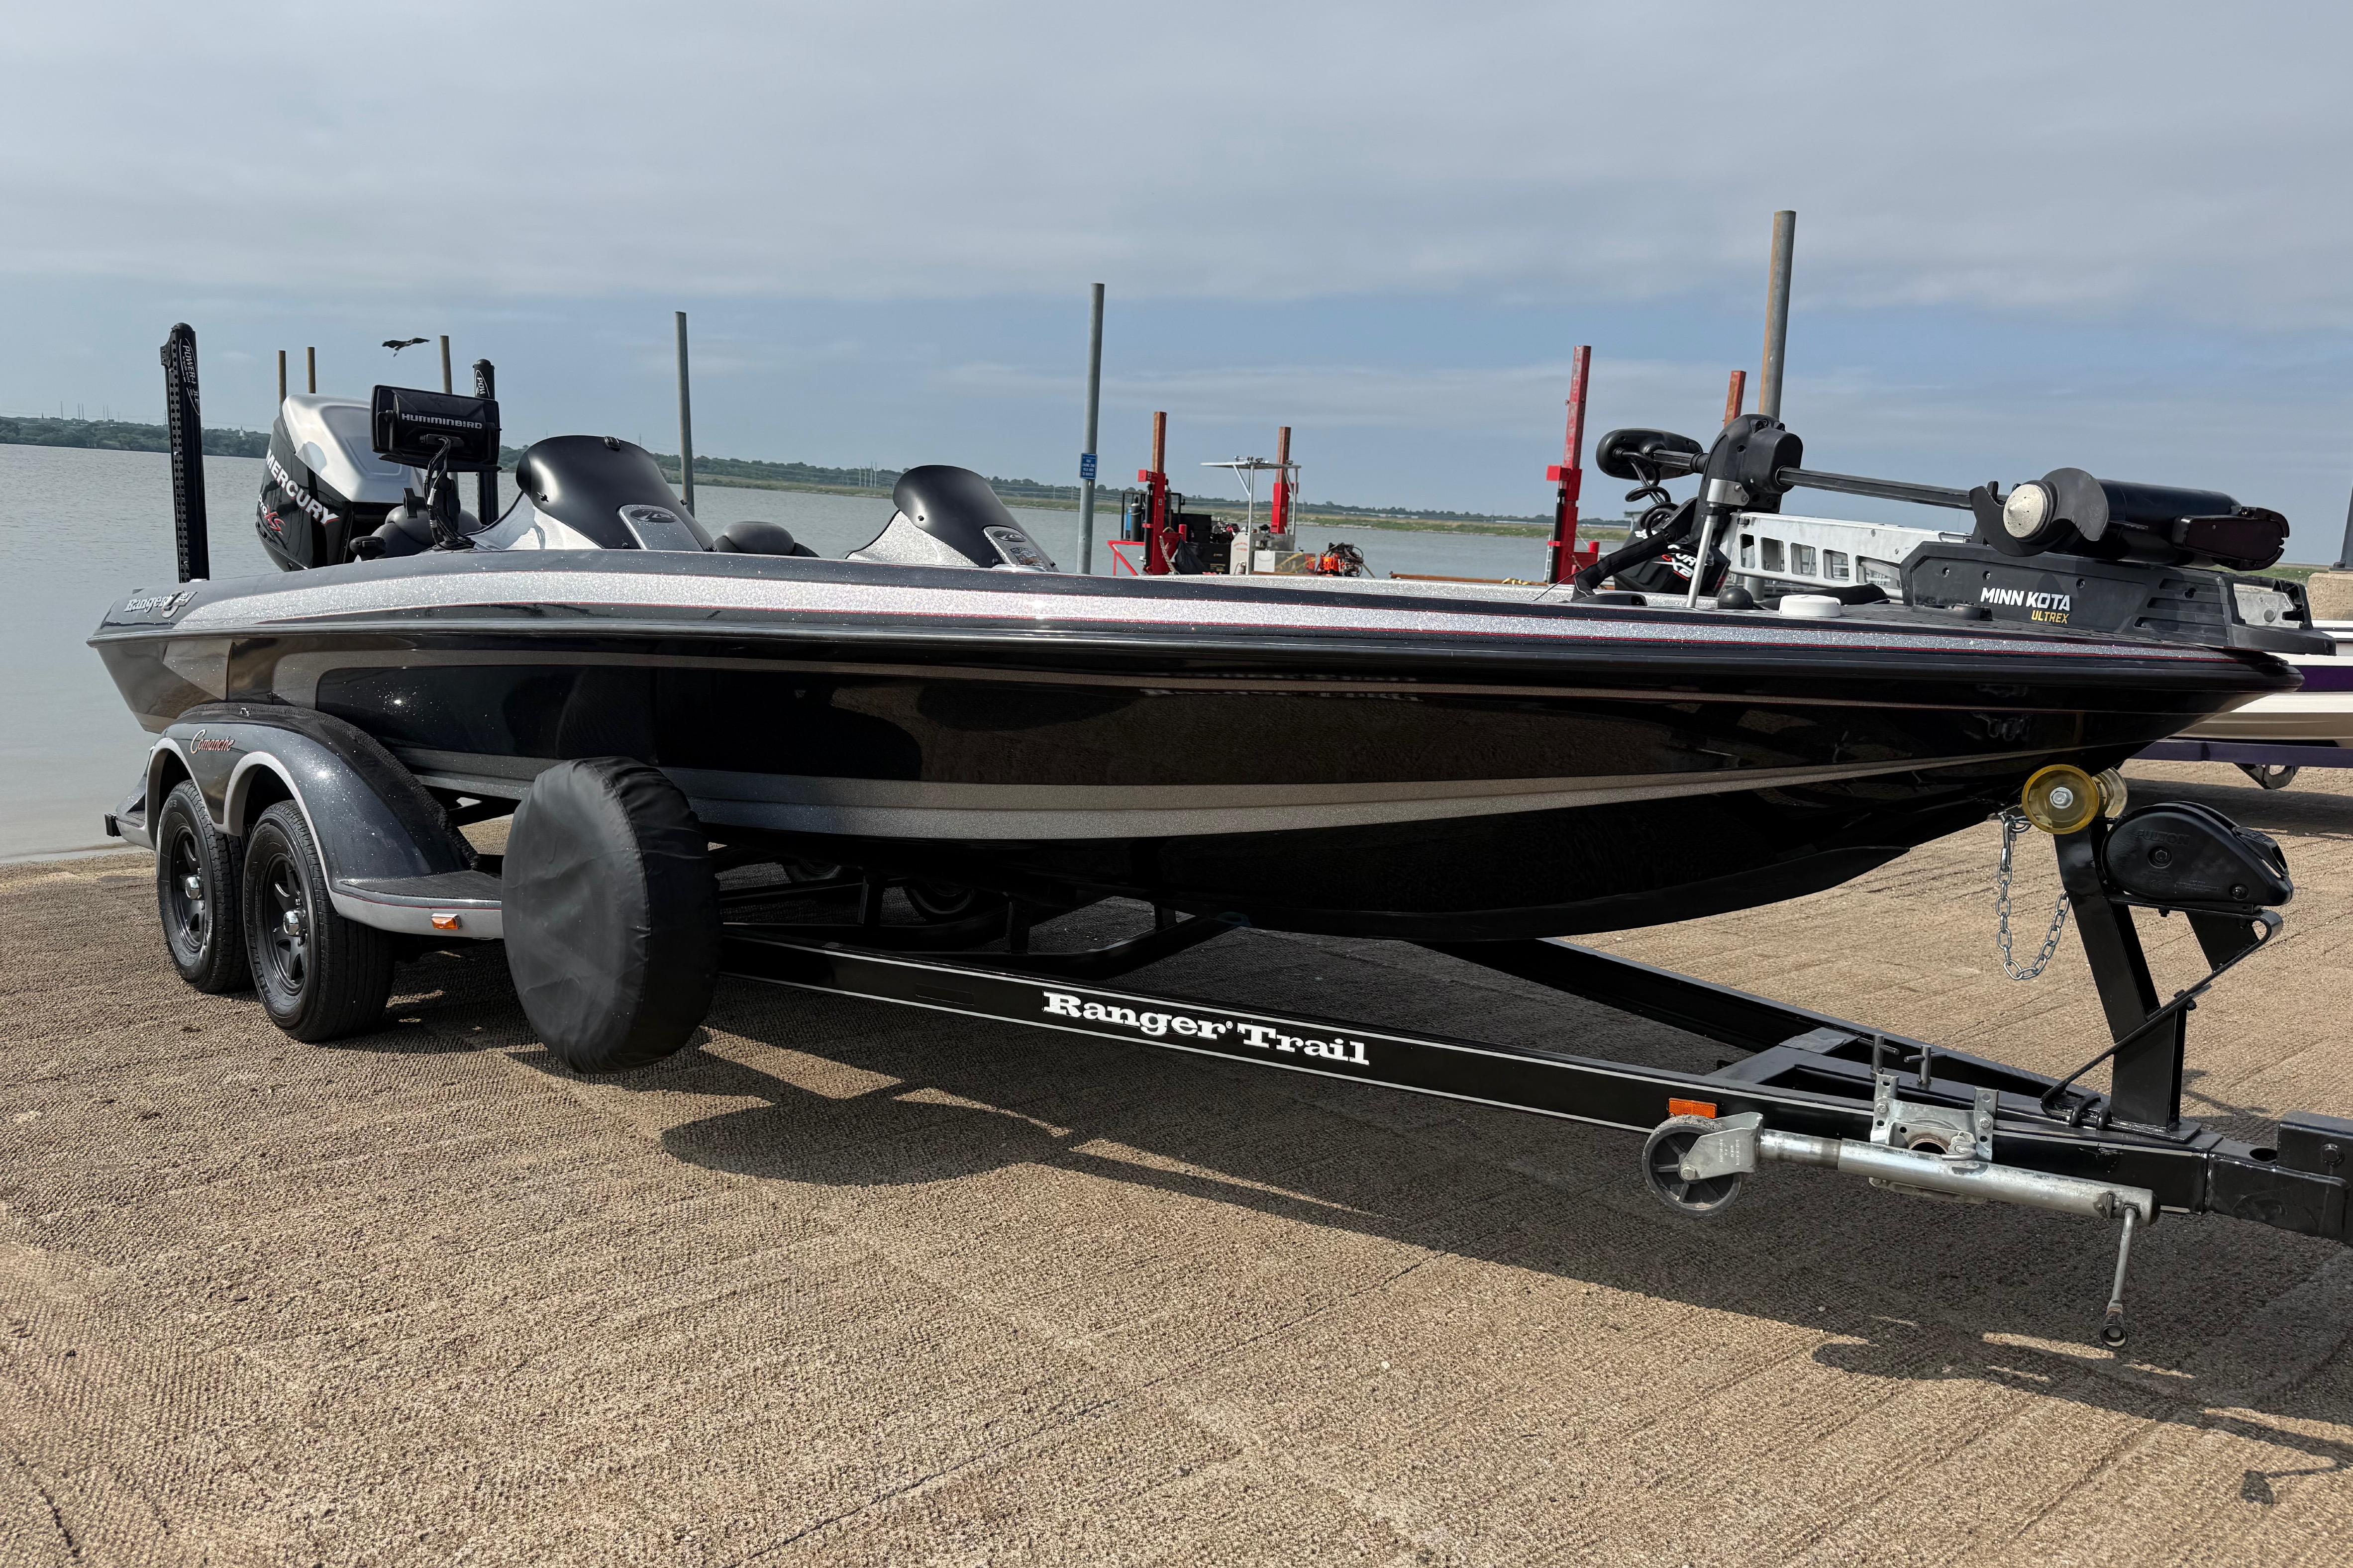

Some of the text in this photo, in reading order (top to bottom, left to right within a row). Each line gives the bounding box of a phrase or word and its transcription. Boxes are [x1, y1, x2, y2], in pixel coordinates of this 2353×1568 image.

[402, 413, 482, 429] HUMMINBIRD
[266, 448, 340, 525] MERCURY
[1980, 587, 2070, 611] MINN KOTA
[2031, 610, 2069, 624] ULTREX
[191, 729, 235, 754] Comanche
[1237, 1022, 1369, 1066] Trail
